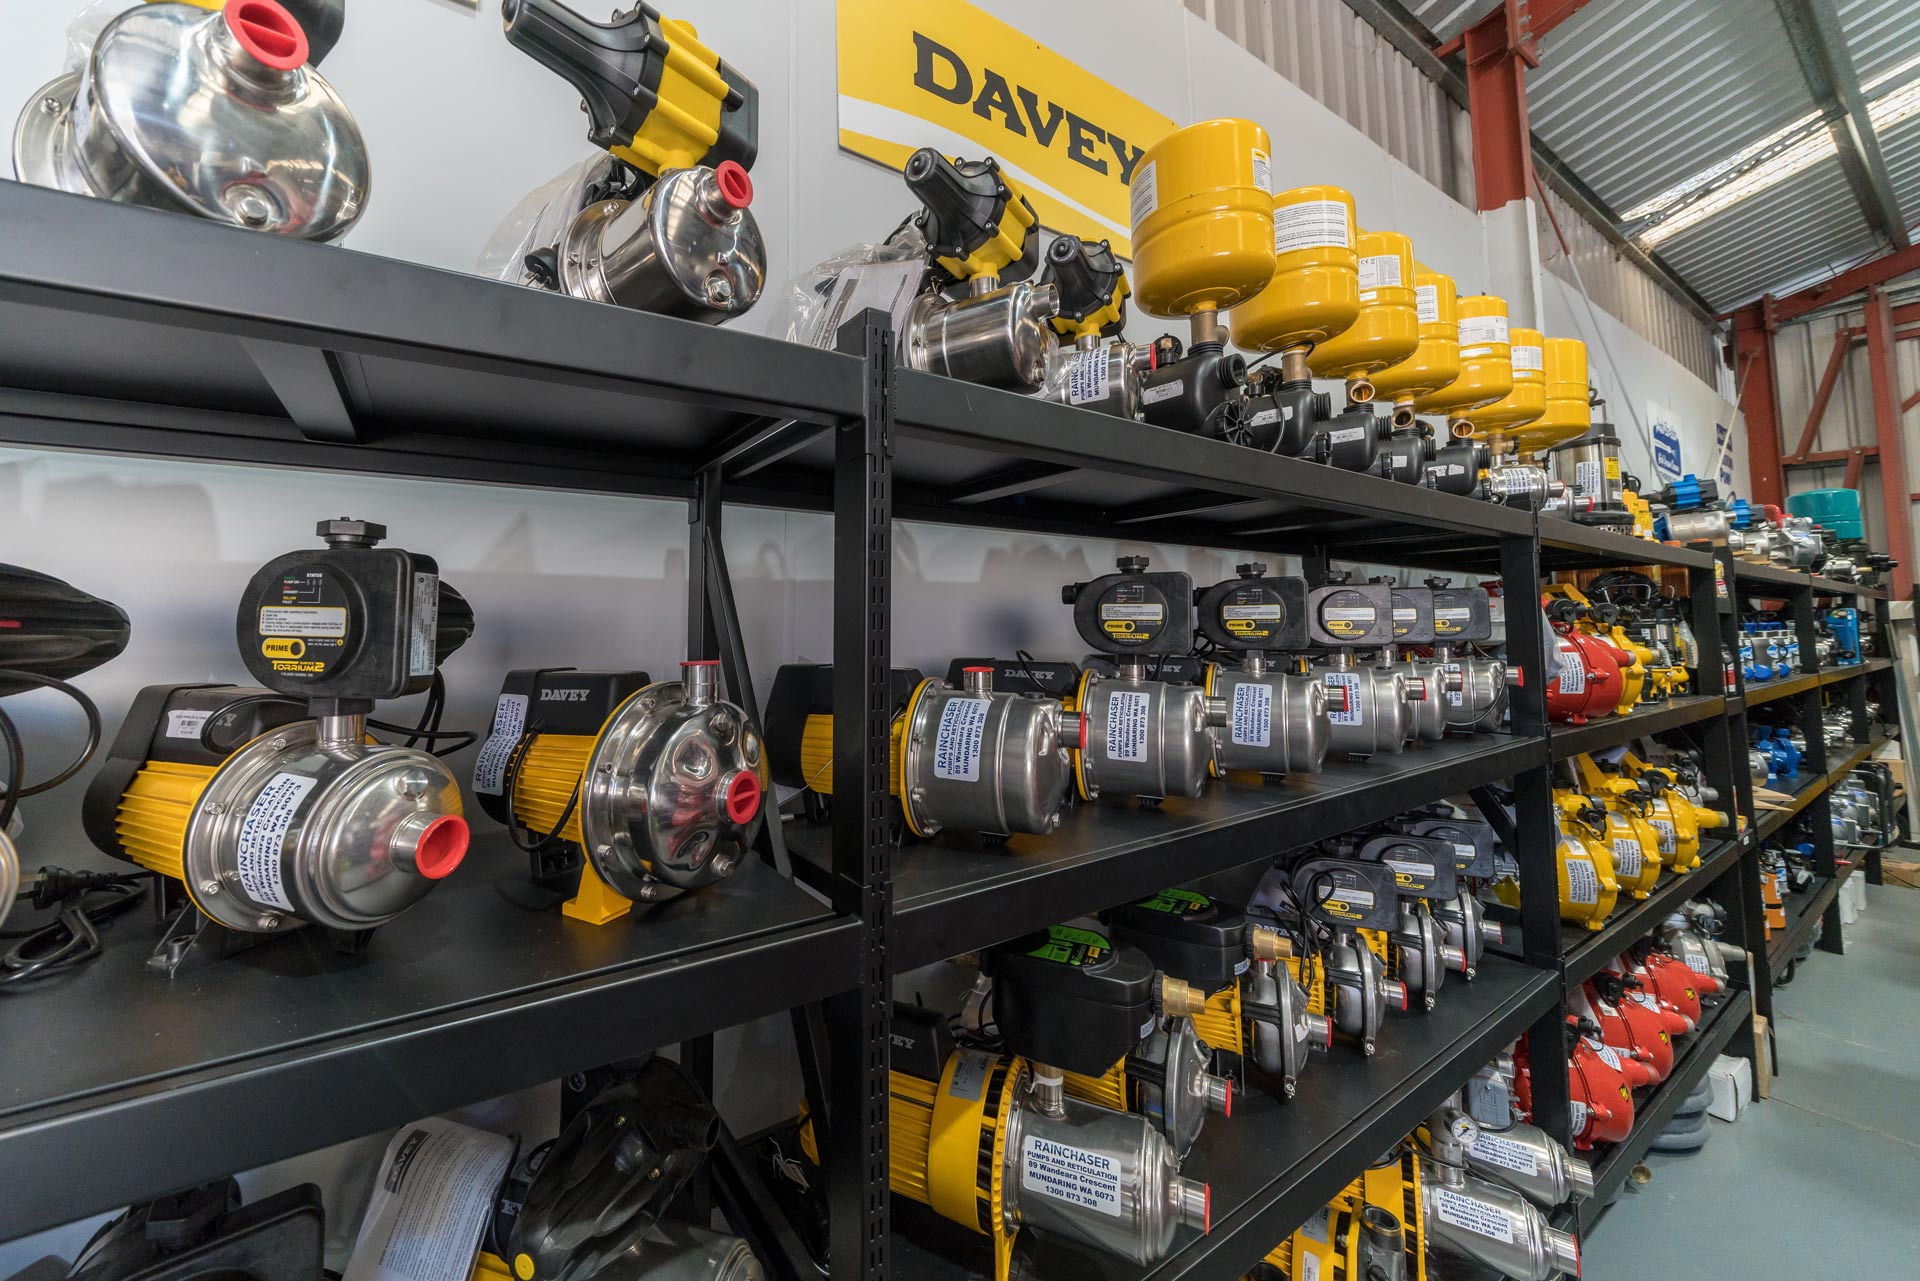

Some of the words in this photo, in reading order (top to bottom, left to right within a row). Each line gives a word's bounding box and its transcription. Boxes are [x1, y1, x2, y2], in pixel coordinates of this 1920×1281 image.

[913, 31, 1145, 186] DAVEY
[1088, 390, 1092, 398] 89
[540, 689, 590, 701] DAVEY
[1258, 700, 1262, 708] WA
[506, 701, 515, 736] Crescent
[952, 701, 965, 735] RETICULATION
[961, 702, 973, 725] Crescent
[1109, 697, 1119, 751] RAINCHASER
[1134, 708, 1138, 717] WA
[1235, 687, 1245, 738] RAINCHASER
[476, 703, 505, 781] RAINCHASER
[938, 702, 958, 768] RAINCHASER
[956, 727, 964, 762] Wandeara
[963, 728, 972, 774] MUNDARING
[969, 716, 975, 726] WA
[972, 703, 980, 714] 6073
[492, 739, 511, 787] MUNDARING
[511, 724, 517, 736] WA
[500, 752, 509, 770] 1300
[955, 765, 960, 774] 89
[281, 785, 302, 810] 6073
[251, 779, 290, 848] RETICULATION
[270, 814, 282, 832] WA
[240, 786, 276, 892] RAINCHASER
[257, 835, 265, 888] Wandeara
[263, 782, 296, 831] Crescent
[273, 834, 281, 856] 873
[280, 809, 292, 830] 308
[264, 837, 280, 903] MUNDARING
[1568, 863, 1577, 899] RAINCHASER
[1035, 1140, 1109, 1170] RAINCHASER
[1474, 1147, 1507, 1160] MUNDARING
[1480, 1134, 1527, 1151] AINCHASER
[392, 1138, 417, 1183] DAVEY
[1027, 1151, 1049, 1161] PUMPS
[1052, 1158, 1065, 1166] AND
[1068, 1163, 1117, 1181] RETICULATION
[1028, 1160, 1037, 1168] 89
[1040, 1164, 1077, 1180] Wandeara
[1080, 1176, 1115, 1192] Crescent
[1029, 1171, 1077, 1190] MUNDARING
[1080, 1186, 1092, 1196] WA
[1095, 1190, 1114, 1202] 6073
[1046, 1186, 1064, 1196] 1300
[1066, 1192, 1080, 1201] 873
[1083, 1197, 1097, 1206] 308
[1439, 1197, 1456, 1205] PUMPS
[1470, 1207, 1508, 1221] RETICULATION
[1444, 1192, 1501, 1215] RAINCHASER
[1450, 1205, 1479, 1218] Wandeara
[1481, 1217, 1507, 1229] Crescent
[1443, 1210, 1479, 1225] MUNDARING
[1493, 1226, 1508, 1234] 6073
